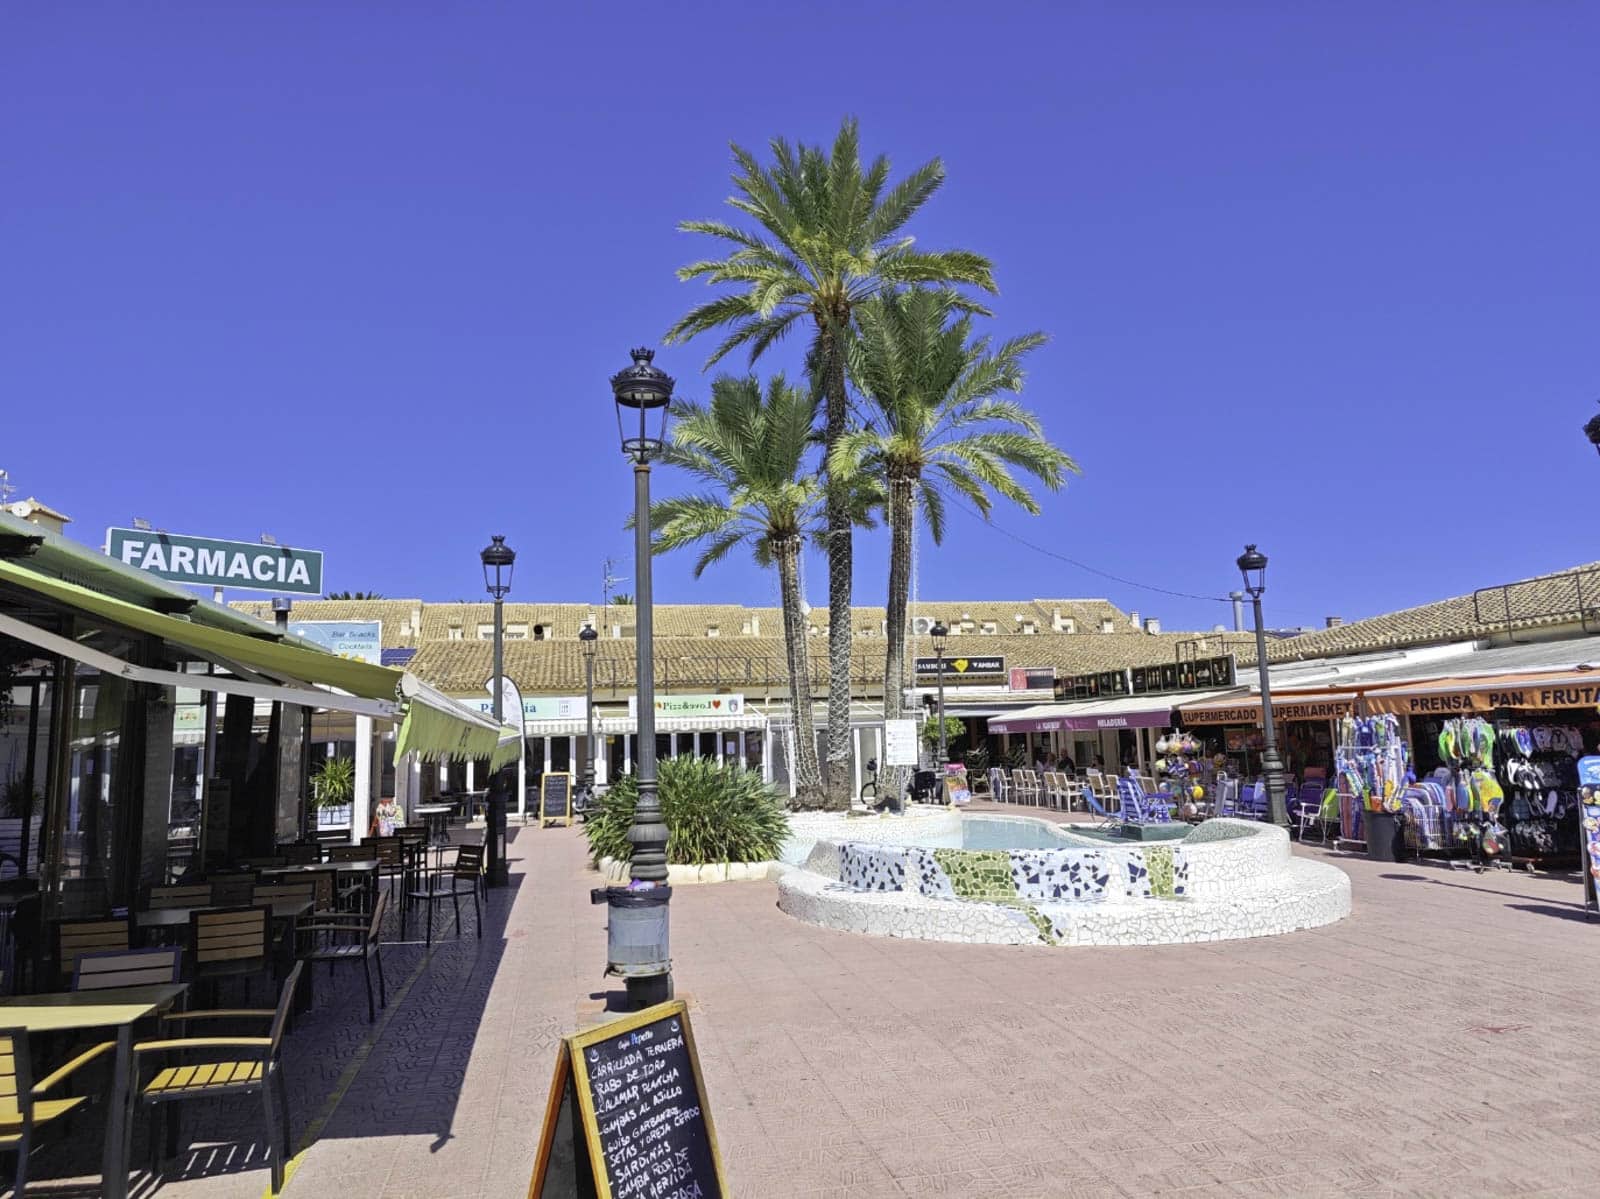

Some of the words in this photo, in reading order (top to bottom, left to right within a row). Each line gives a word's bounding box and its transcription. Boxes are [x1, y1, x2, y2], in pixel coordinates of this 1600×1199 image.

[121, 539, 311, 585] FARMACIA
[1184, 709, 1257, 722] SUPERMERCADO
[1271, 702, 1351, 718] UPERMARKET
[1411, 695, 1473, 711] PRENSA
[1489, 691, 1524, 706] PAN
[645, 1034, 684, 1057] TERNERA
[594, 1078, 622, 1097] RABO
[626, 1069, 639, 1083] DE
[642, 1059, 666, 1078] TORO
[599, 1085, 640, 1113] CALAMAR
[602, 1109, 637, 1136] GAMBAS
[640, 1102, 650, 1116] AL
[609, 1144, 637, 1168] SETAS
[646, 1123, 671, 1144] OREJA
[674, 1106, 700, 1127] CERDO
[618, 1170, 650, 1199] GAMBA
[675, 1146, 689, 1165] DE
